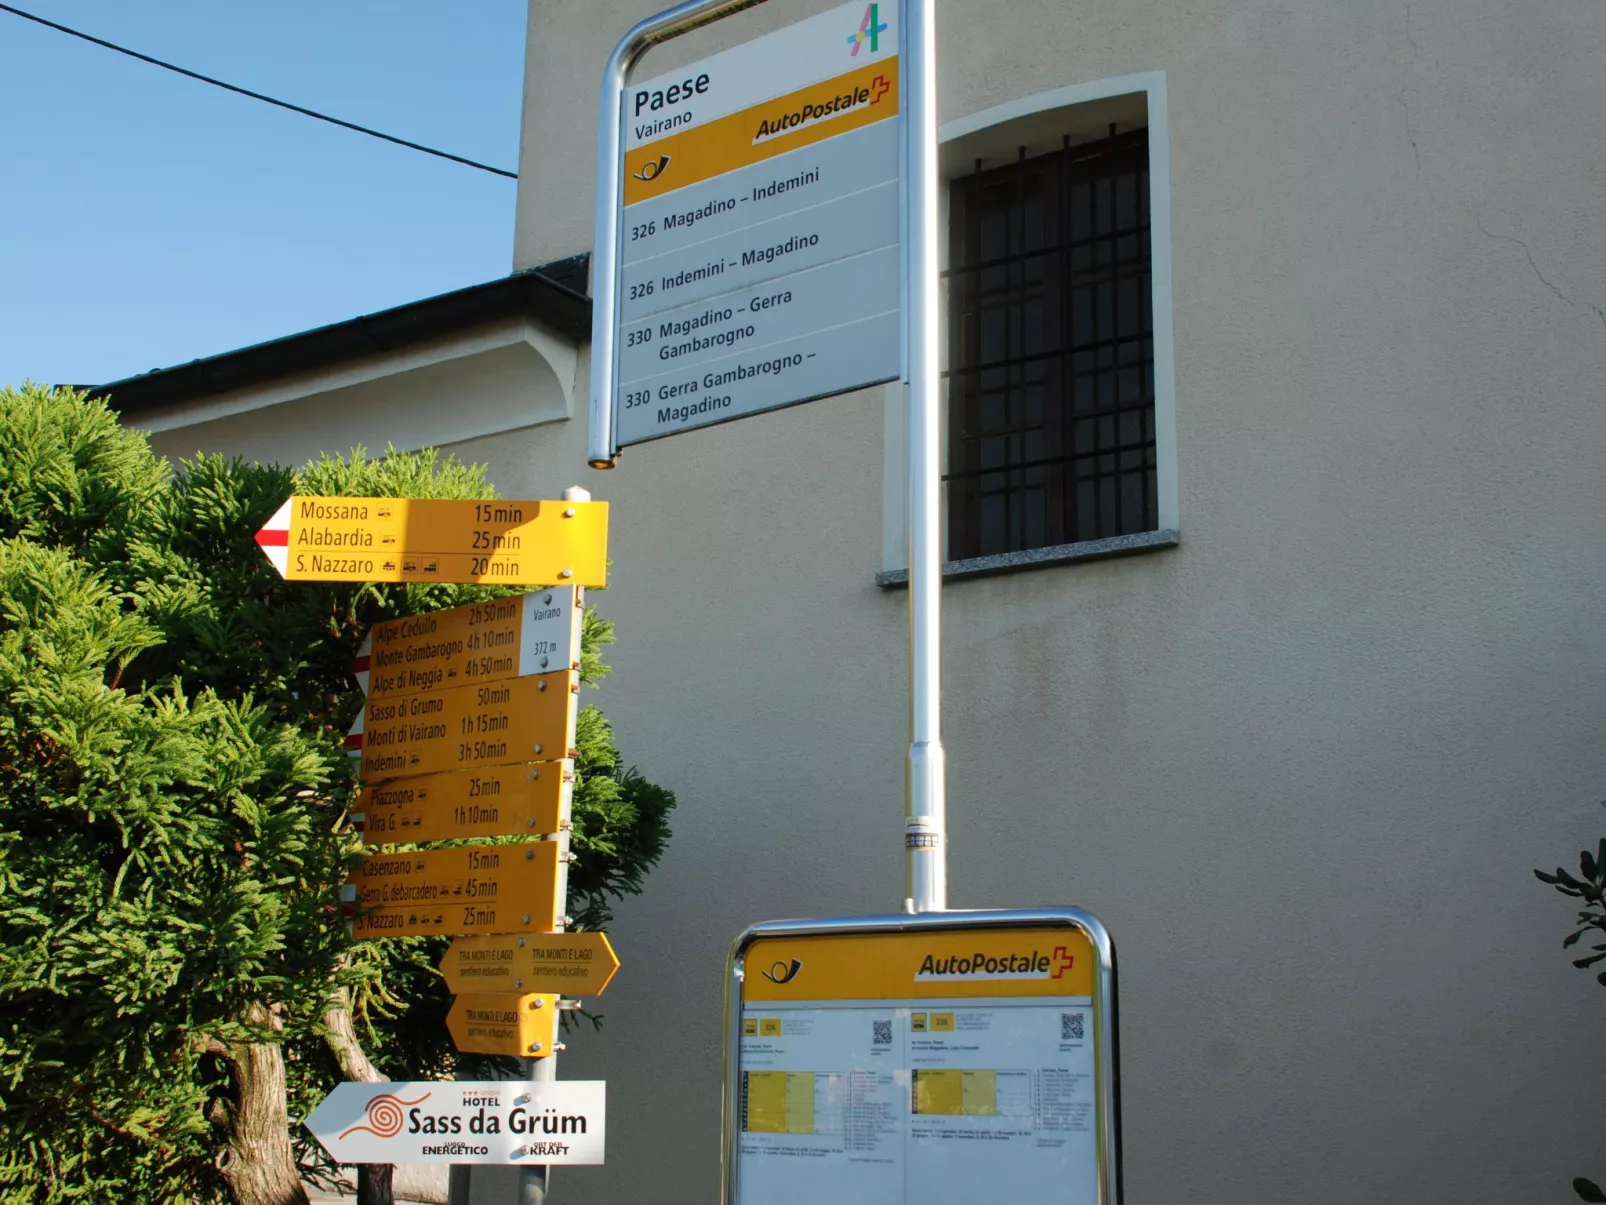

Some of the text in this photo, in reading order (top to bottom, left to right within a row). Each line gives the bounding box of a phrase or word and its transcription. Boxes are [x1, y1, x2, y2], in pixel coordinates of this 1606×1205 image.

[635, 73, 710, 117] Paese
[755, 86, 870, 139] AutoPostale
[635, 111, 693, 140] Vairano
[631, 221, 656, 241] 326
[663, 199, 736, 231] Magadino
[753, 167, 819, 202] Indemini
[629, 280, 654, 300] 326
[661, 259, 725, 290] Indemini
[741, 233, 819, 266] Magadino
[627, 328, 651, 347] 330
[659, 308, 733, 338] Magadino
[750, 290, 792, 312] Gerra
[659, 324, 755, 360] Gambarogno
[625, 389, 650, 409] 330
[658, 379, 698, 400] Gerra
[703, 353, 802, 389] Gambarogno
[657, 395, 731, 424] Magadino
[301, 501, 368, 520] Mossana
[297, 527, 373, 547] Alabardia
[296, 554, 307, 573] S.
[312, 555, 374, 574] Nazzaro
[533, 606, 561, 621] Vairano
[377, 625, 398, 645] Alpe
[401, 616, 437, 638] Cedullo
[375, 649, 403, 668] Monte
[405, 639, 463, 663] Gambarogno
[534, 642, 548, 655] 372
[373, 675, 395, 695] Alpe
[397, 671, 406, 689] di
[408, 665, 443, 690] Neggia
[369, 703, 395, 722] Sasso
[398, 701, 407, 717] di
[410, 697, 443, 716] Grumo
[367, 727, 395, 747] Monti
[398, 724, 407, 739] di
[409, 723, 446, 741] Vairano
[365, 752, 407, 773] Indemini
[370, 788, 414, 809] Piazzogna
[369, 815, 386, 832] Vira
[388, 814, 397, 831] G.
[362, 859, 411, 877] Casenzano
[361, 885, 380, 903] Gerra
[390, 882, 437, 902] debarcadero
[367, 912, 404, 930] Nazzaro
[459, 949, 514, 961] TRA MONTI E LAGO
[532, 949, 593, 960] TRA MONTI E LAGO
[918, 950, 1051, 977] AutoPostale
[466, 1010, 477, 1020] TRA
[477, 1010, 495, 1021] MONTI
[499, 1011, 518, 1023] LAGO
[463, 1098, 500, 1107] HOTEL
[408, 1108, 587, 1134] Sass da Grüm
[422, 1146, 570, 1156] ENERGETICO KRAFT
